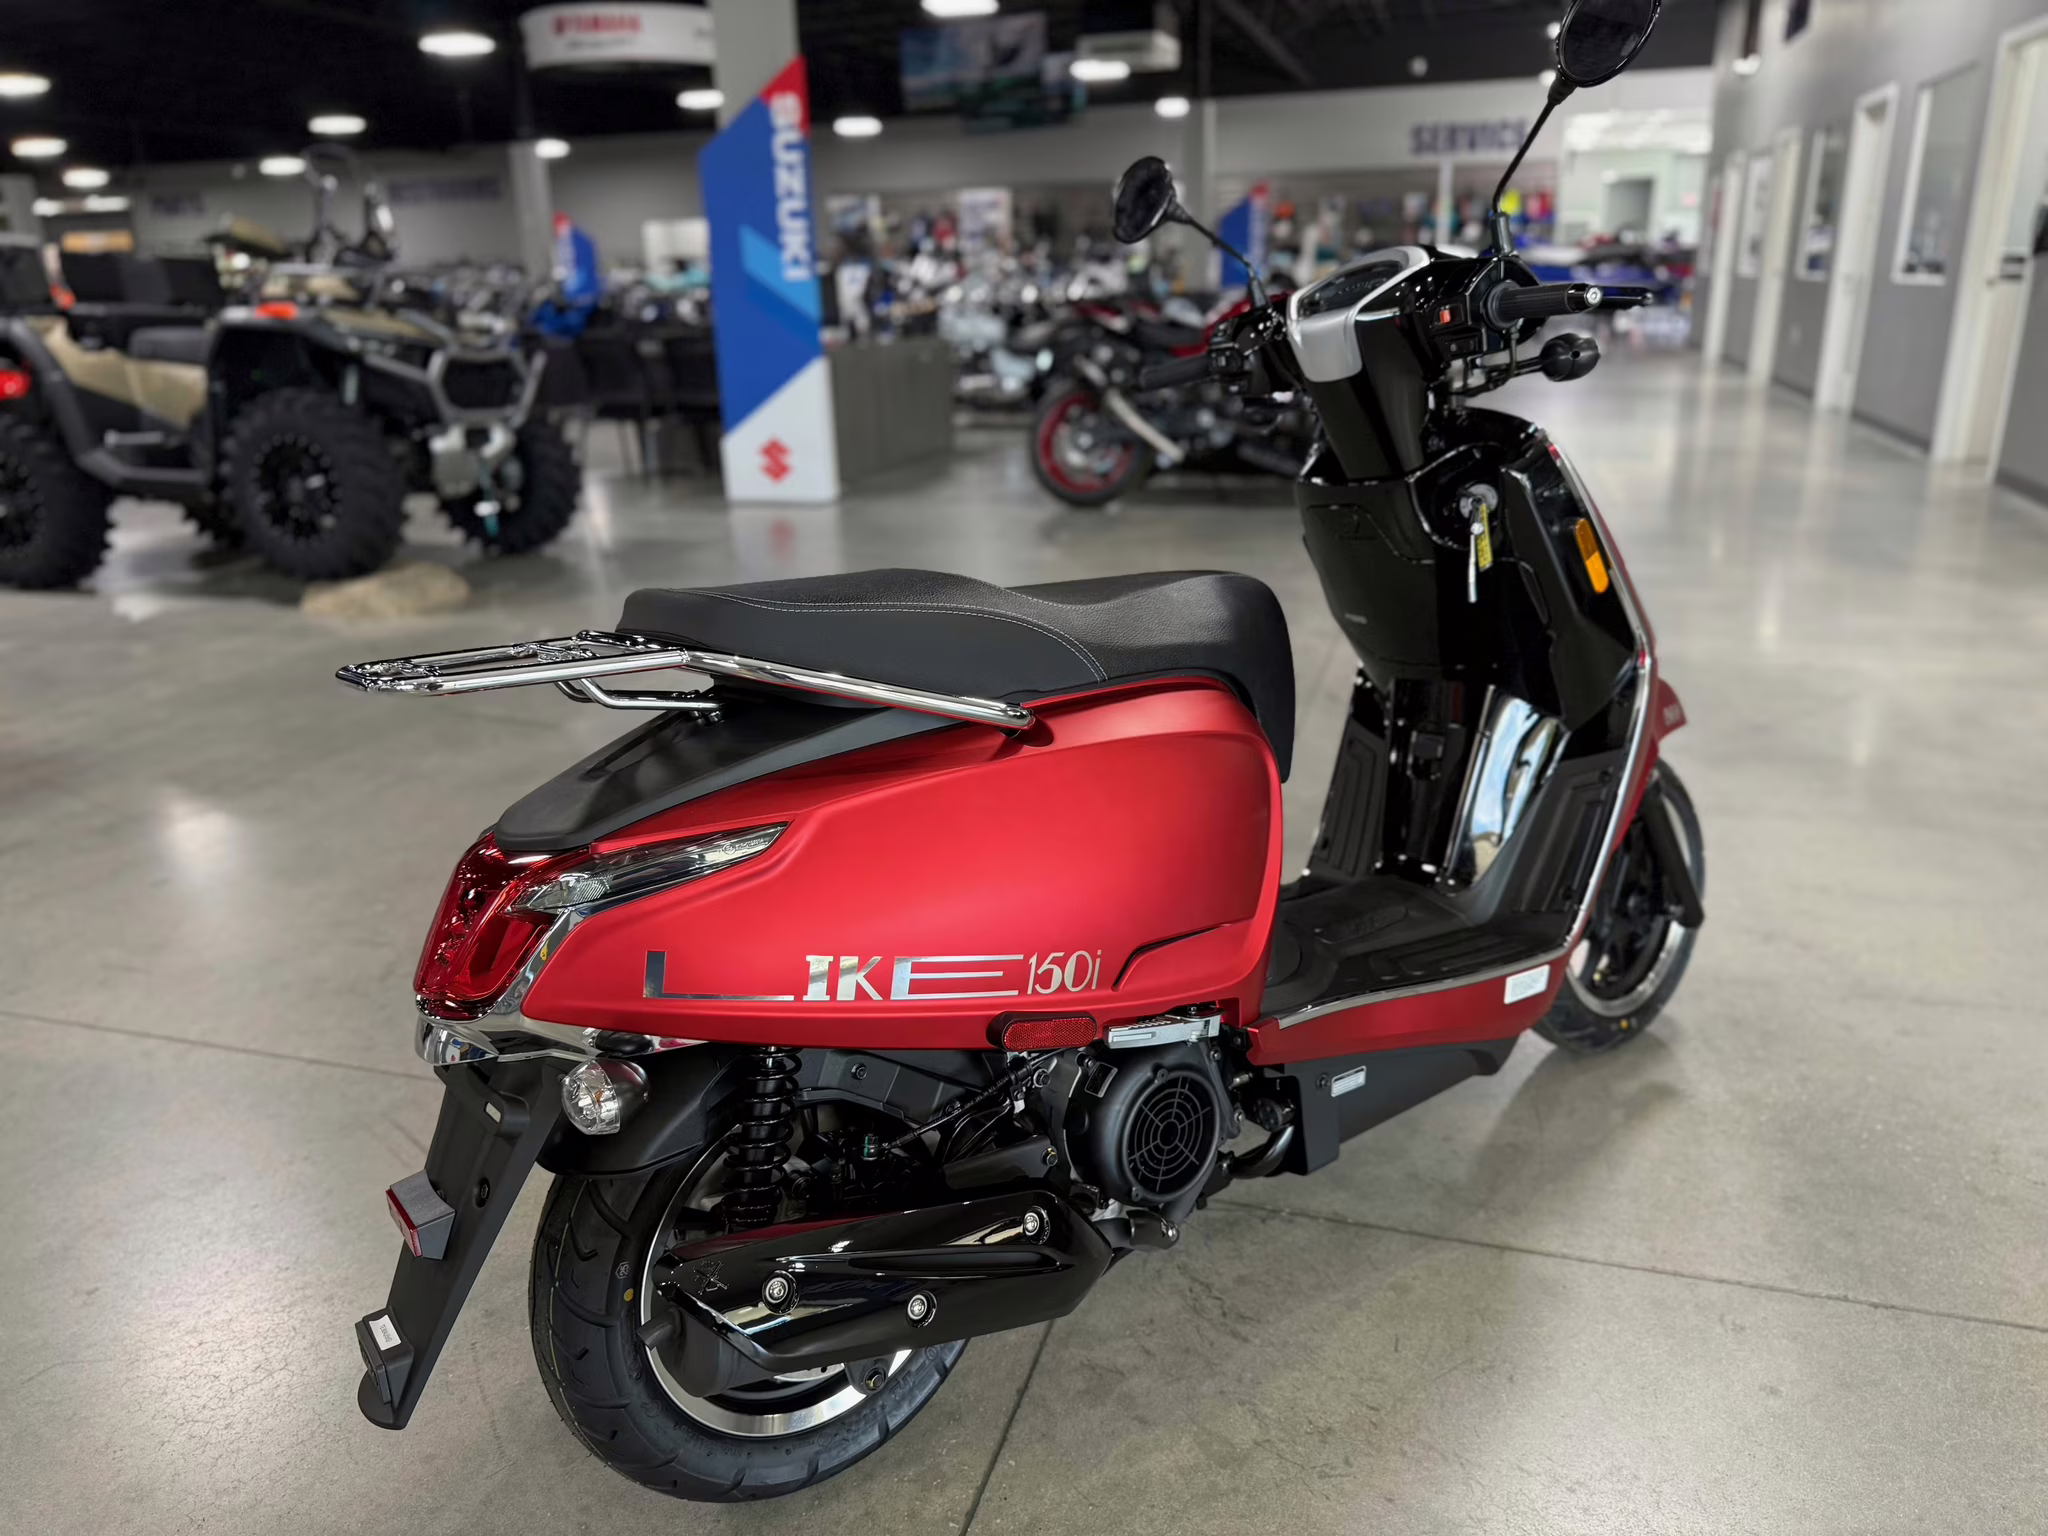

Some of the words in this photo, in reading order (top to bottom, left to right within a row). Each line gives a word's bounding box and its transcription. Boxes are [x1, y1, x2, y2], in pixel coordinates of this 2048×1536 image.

[770, 92, 812, 282] SUZUKI
[643, 950, 1024, 1001] LIKE
[1026, 949, 1102, 995] 150i
